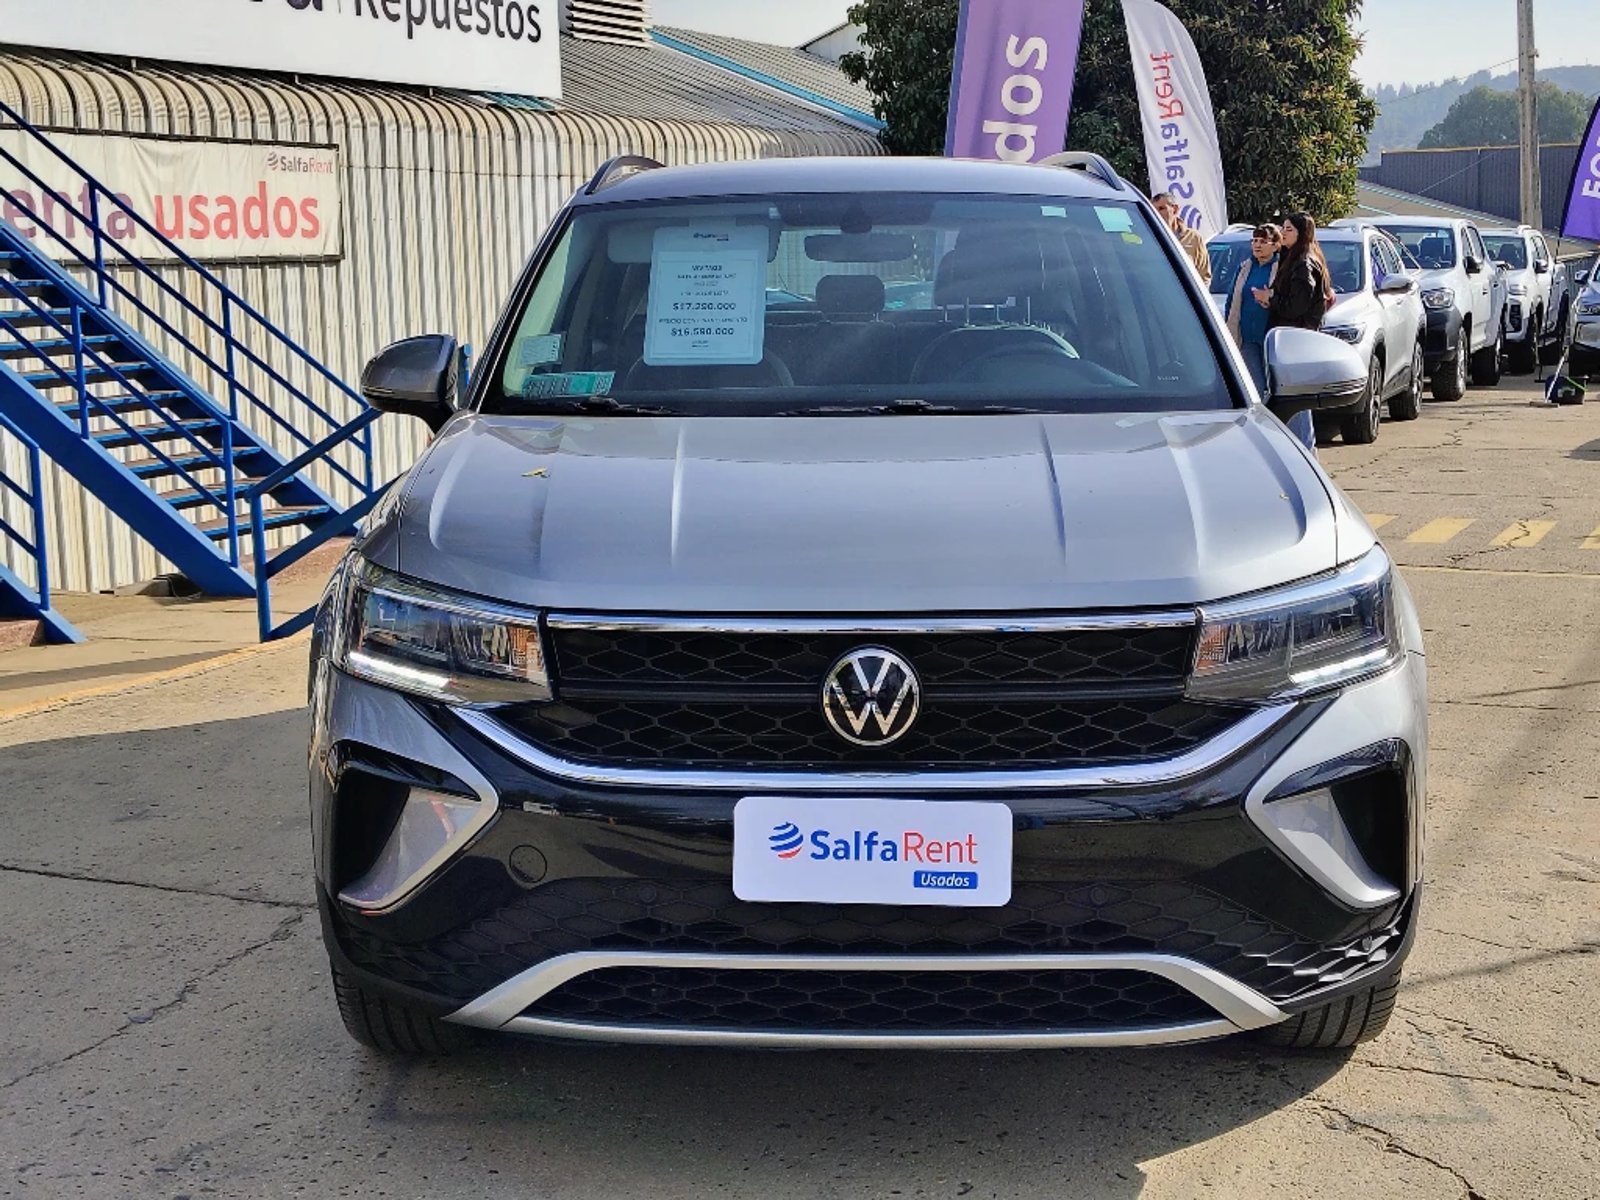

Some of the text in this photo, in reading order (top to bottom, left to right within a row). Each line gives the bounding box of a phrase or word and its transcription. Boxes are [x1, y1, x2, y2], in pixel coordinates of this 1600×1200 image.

[280, 156, 333, 174] SalfaRent
[154, 181, 320, 240] usados
[810, 830, 978, 864] SalfaRent
[920, 872, 970, 888] Usados
